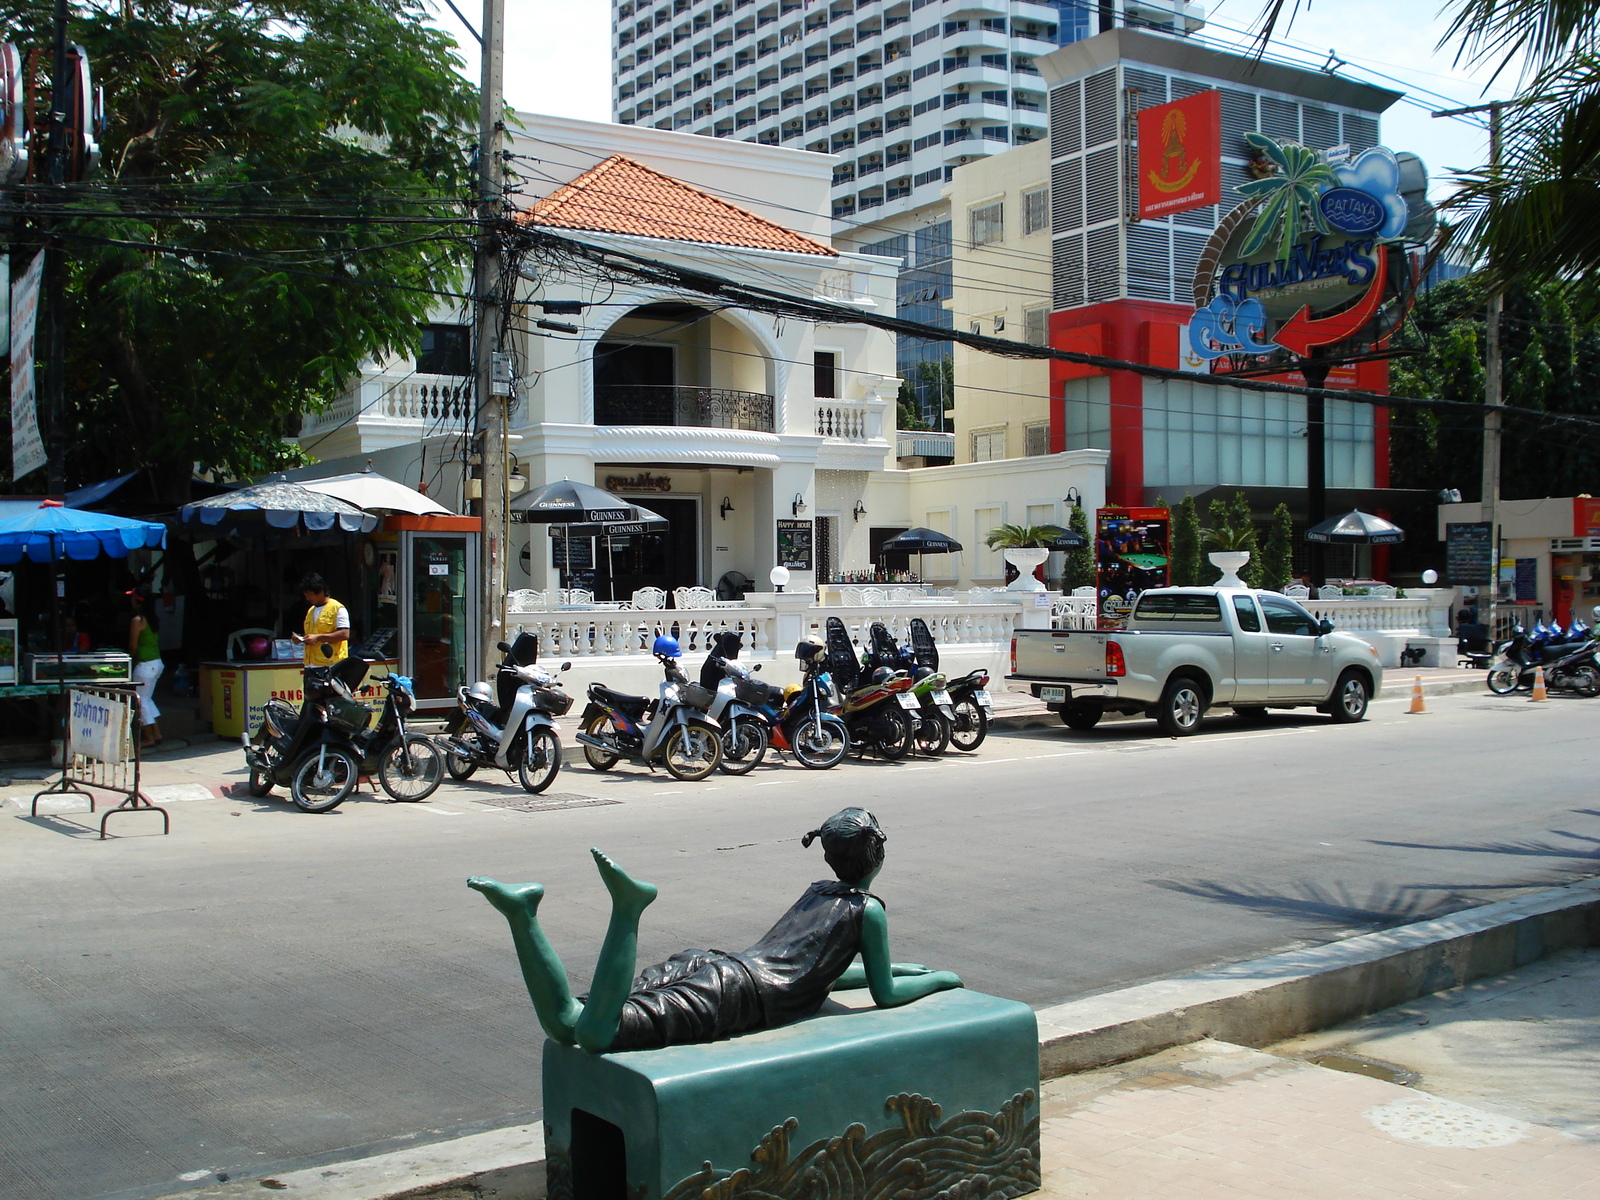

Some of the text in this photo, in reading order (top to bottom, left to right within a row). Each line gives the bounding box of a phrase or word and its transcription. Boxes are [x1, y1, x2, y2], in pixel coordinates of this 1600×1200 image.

[1326, 198, 1376, 216] PATTAYA
[590, 510, 626, 522] GUINNESS
[608, 524, 643, 534] GUINNESS
[797, 521, 811, 529] HOUR
[1372, 535, 1398, 543] GUINNESS
[926, 540, 949, 548] GUINNESS
